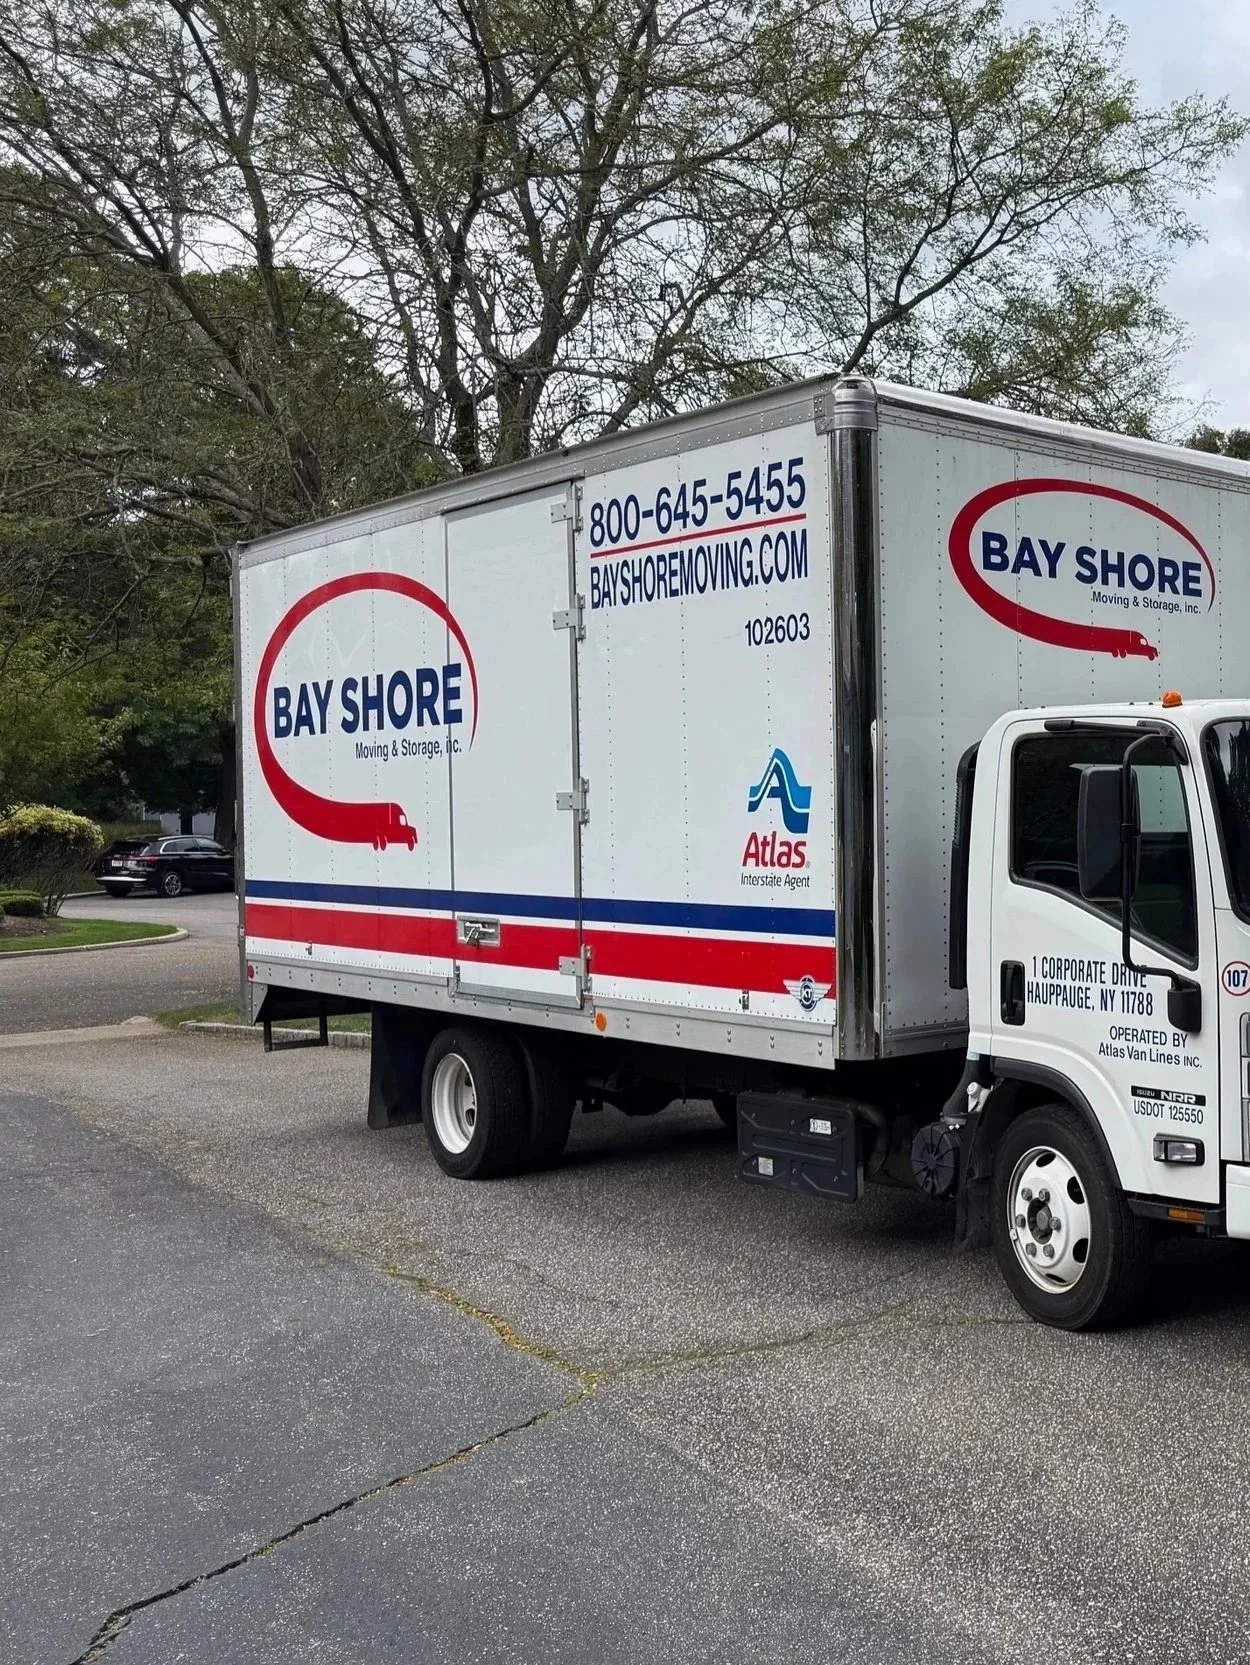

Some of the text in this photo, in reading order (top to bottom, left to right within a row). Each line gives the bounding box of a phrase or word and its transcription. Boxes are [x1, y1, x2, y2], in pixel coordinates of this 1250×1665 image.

[590, 457, 806, 547] 800-645-5455
[590, 528, 808, 610] BAYSHOREMOVING.COM
[981, 531, 1202, 598] BAY SHORE
[1092, 591, 1130, 609] Moving
[1133, 596, 1140, 608] &
[1142, 597, 1182, 615] Storage,
[745, 612, 810, 647] 102603
[273, 663, 463, 739] BAY SHORE
[355, 742, 389, 762] Moving
[391, 740, 399, 757] &
[401, 738, 443, 760] Storage,
[742, 831, 807, 868] Atlas
[741, 872, 811, 890] Interstate Agent
[1032, 955, 1037, 978] 1
[1041, 956, 1106, 984] CORPORATE
[1227, 969, 1248, 987] 107
[1027, 981, 1153, 1016] HAUPPAUGE, NY 11788
[1109, 1025, 1188, 1048] OPERATED BY
[1098, 1042, 1203, 1068] Atlas Van Lines INC.
[1136, 1089, 1197, 1104] ISUZU NRR
[1133, 1099, 1204, 1125] USDOT 125550
